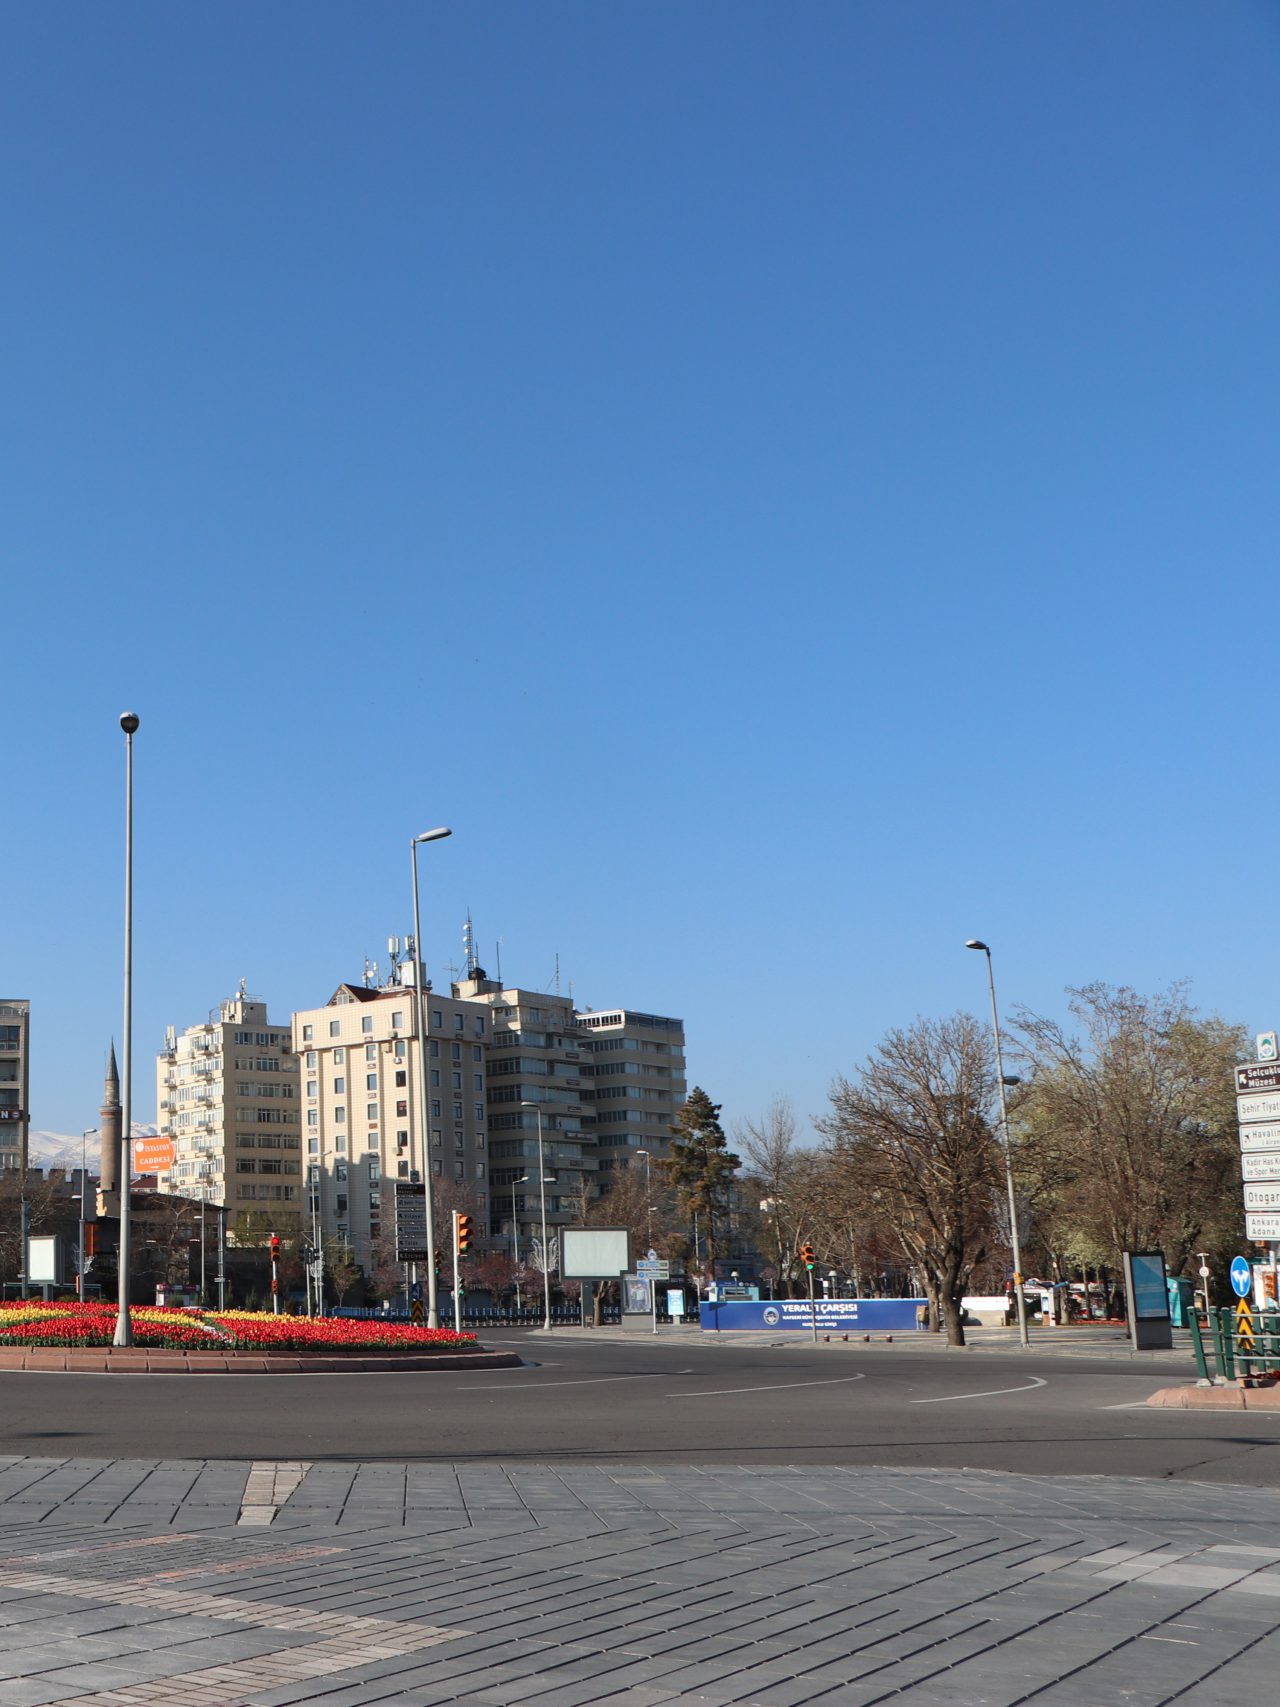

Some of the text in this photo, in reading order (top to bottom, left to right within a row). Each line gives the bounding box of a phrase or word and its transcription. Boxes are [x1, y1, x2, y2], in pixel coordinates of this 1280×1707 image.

[1248, 1076, 1276, 1088] Müzesi
[139, 1155, 171, 1165] CADDESİ
[1248, 1191, 1280, 1205] Otogar
[1251, 1217, 1280, 1227] Ankara
[1252, 1227, 1276, 1236] Adana
[820, 1303, 858, 1315] ÇARŞISI
